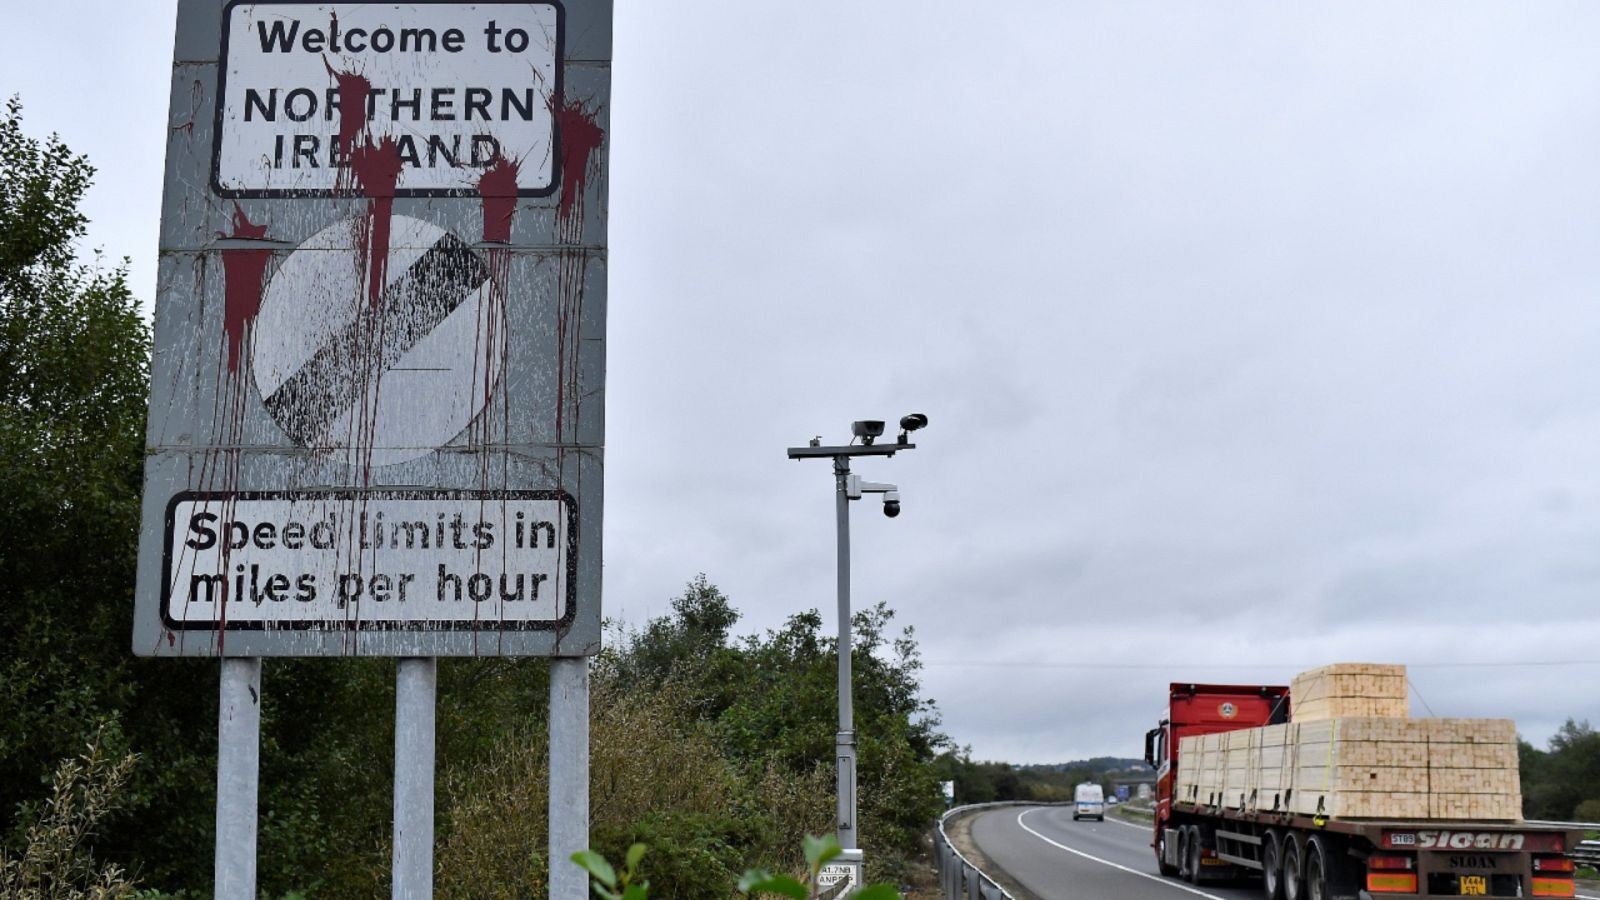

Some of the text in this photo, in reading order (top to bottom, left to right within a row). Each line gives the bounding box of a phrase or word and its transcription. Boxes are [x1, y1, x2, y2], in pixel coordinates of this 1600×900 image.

[257, 19, 530, 53] Welcome to
[274, 134, 501, 168] IREAND
[185, 510, 556, 553] Speed limits in
[189, 563, 548, 609] miles per hour
[1450, 855, 1497, 868] SLOAN
